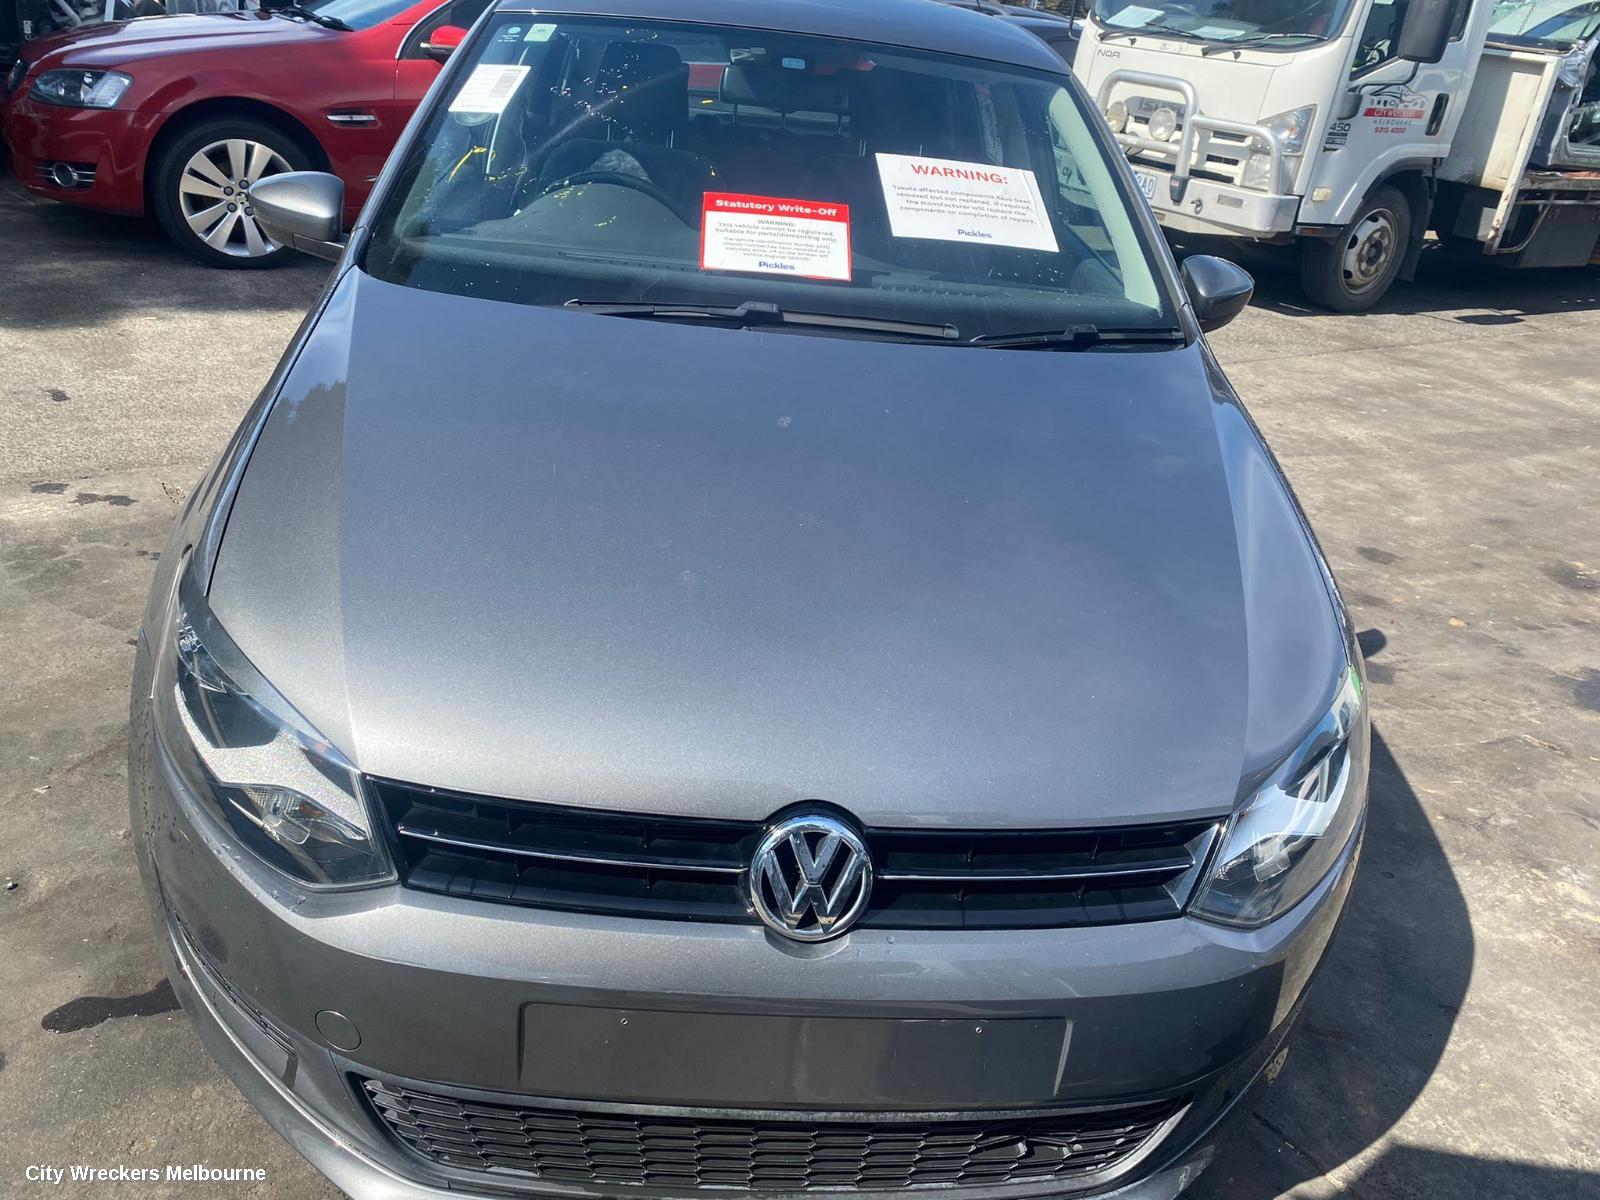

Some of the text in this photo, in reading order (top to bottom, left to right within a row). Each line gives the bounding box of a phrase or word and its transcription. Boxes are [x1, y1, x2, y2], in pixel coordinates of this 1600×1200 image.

[1097, 49, 1120, 58] NQR
[1330, 123, 1351, 132] 450
[911, 164, 1008, 184] WARNING:
[950, 190, 995, 199] components
[715, 199, 837, 216] Statutory Write-Off
[921, 201, 969, 210] manufacturer
[900, 206, 945, 214] components
[959, 211, 998, 220] completion
[757, 219, 796, 227] WARNING:
[957, 228, 992, 238] Pickles
[758, 261, 795, 270] Pickles
